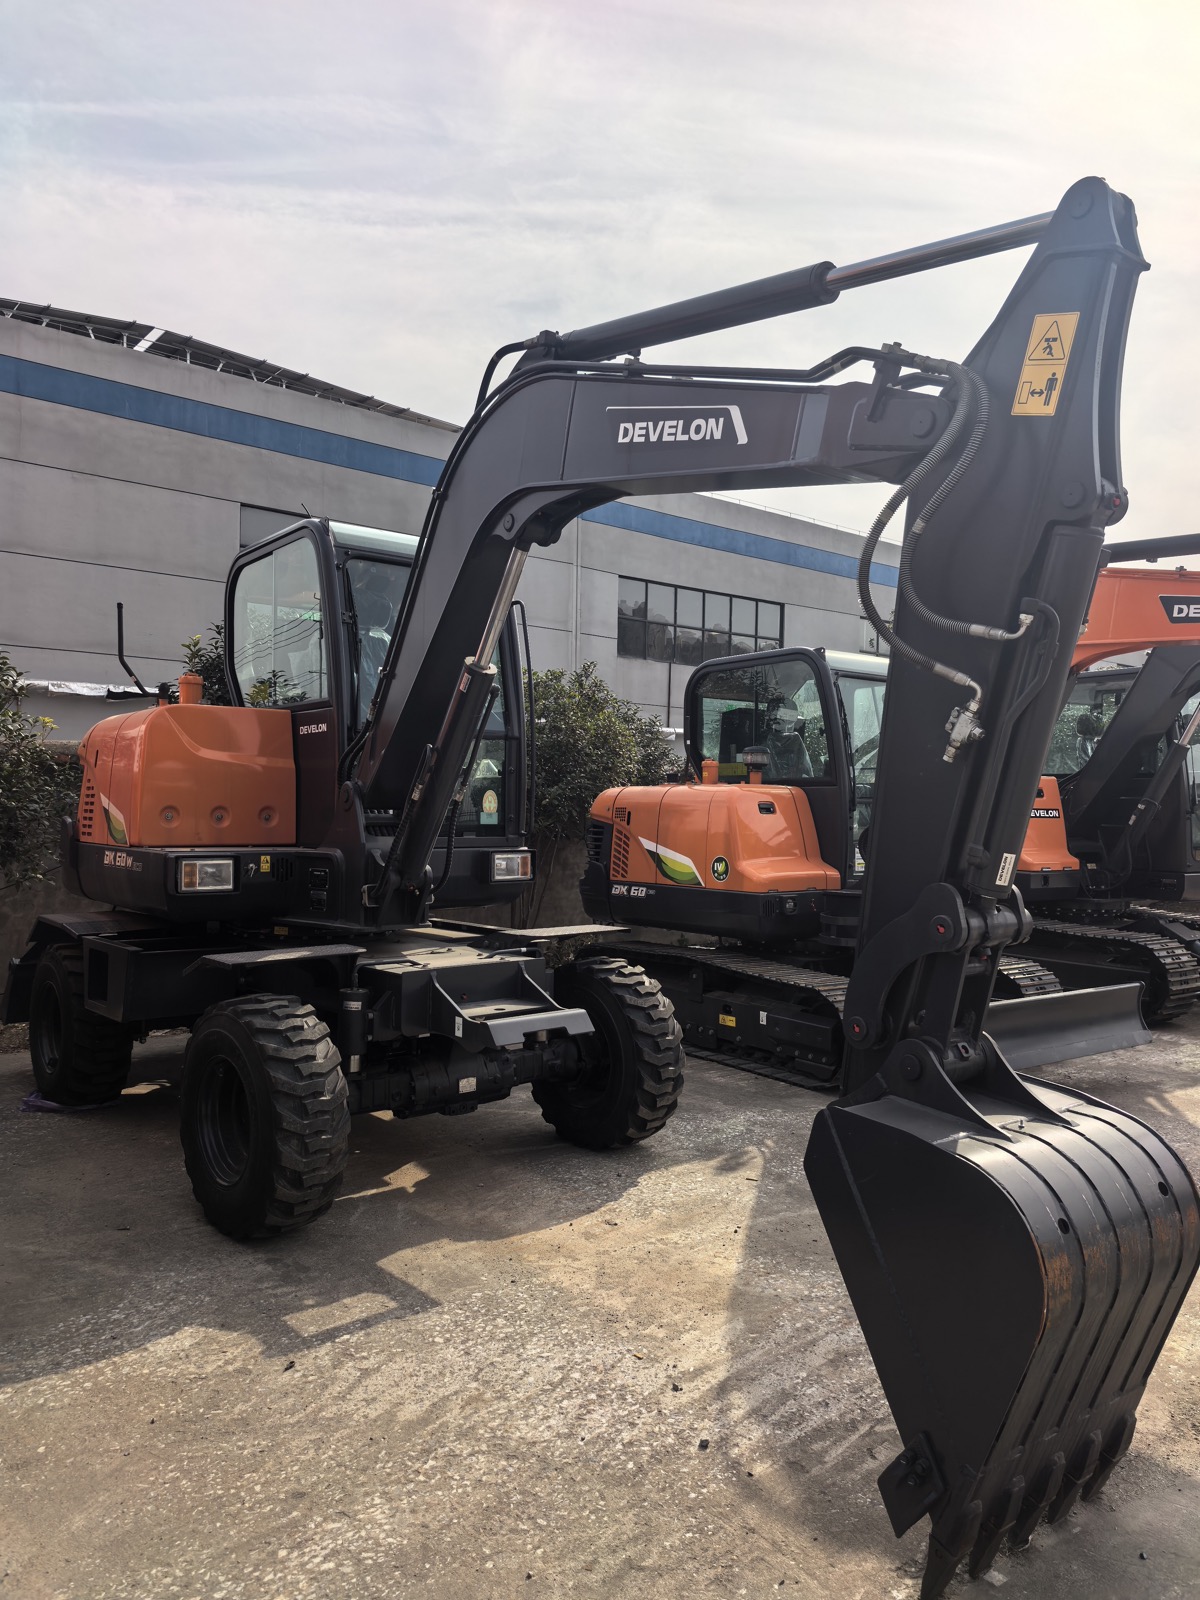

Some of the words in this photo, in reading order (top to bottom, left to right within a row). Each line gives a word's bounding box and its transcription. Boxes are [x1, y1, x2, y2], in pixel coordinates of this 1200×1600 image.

[618, 418, 724, 444] DEVELON
[299, 723, 328, 735] DEVELON
[997, 855, 1009, 882] DEVELON
[630, 886, 647, 898] 60
